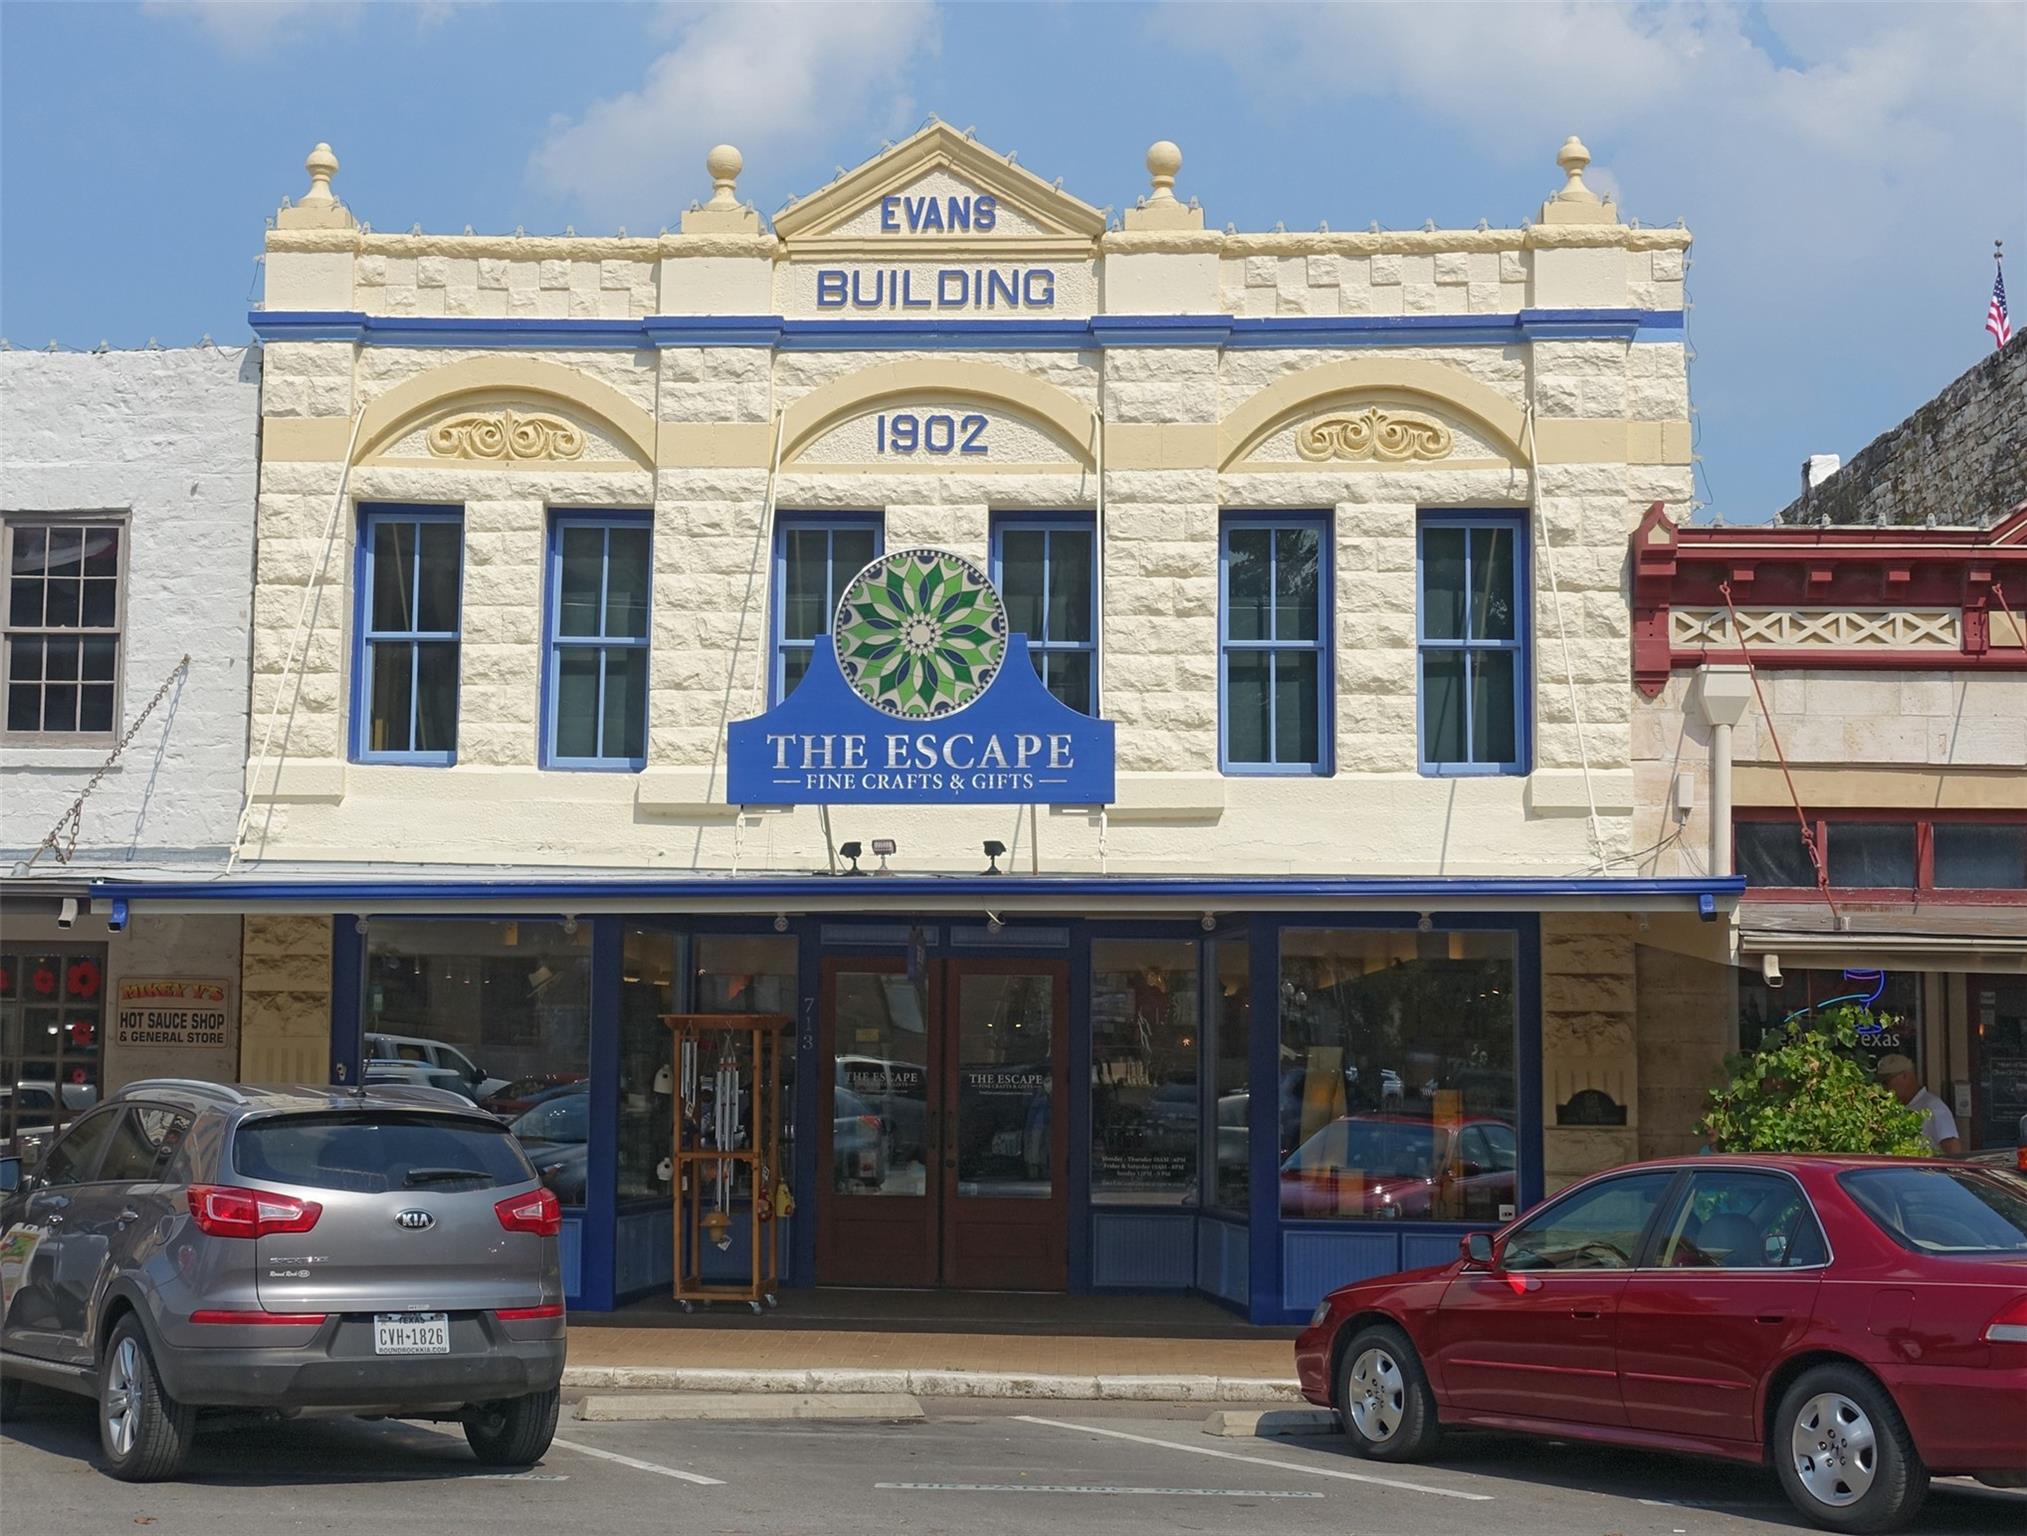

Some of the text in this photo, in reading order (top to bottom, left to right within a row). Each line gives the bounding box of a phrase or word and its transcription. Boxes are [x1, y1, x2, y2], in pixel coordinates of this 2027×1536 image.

[881, 195, 997, 231] EVANS
[817, 269, 1055, 308] BUILDING
[877, 414, 989, 453] 1902
[766, 733, 1074, 769] THE ESCAPE
[806, 773, 1034, 790] FINE CRAFTS & GIFTS
[120, 1012, 225, 1030] HOT SAUCE SHOP
[803, 997, 815, 1050] 713
[119, 1031, 224, 1043] & GENERAL STORE
[847, 1071, 918, 1083] THE ESCAPE
[969, 1073, 1043, 1085] THE ESCAPE
[402, 1213, 430, 1227] KIA
